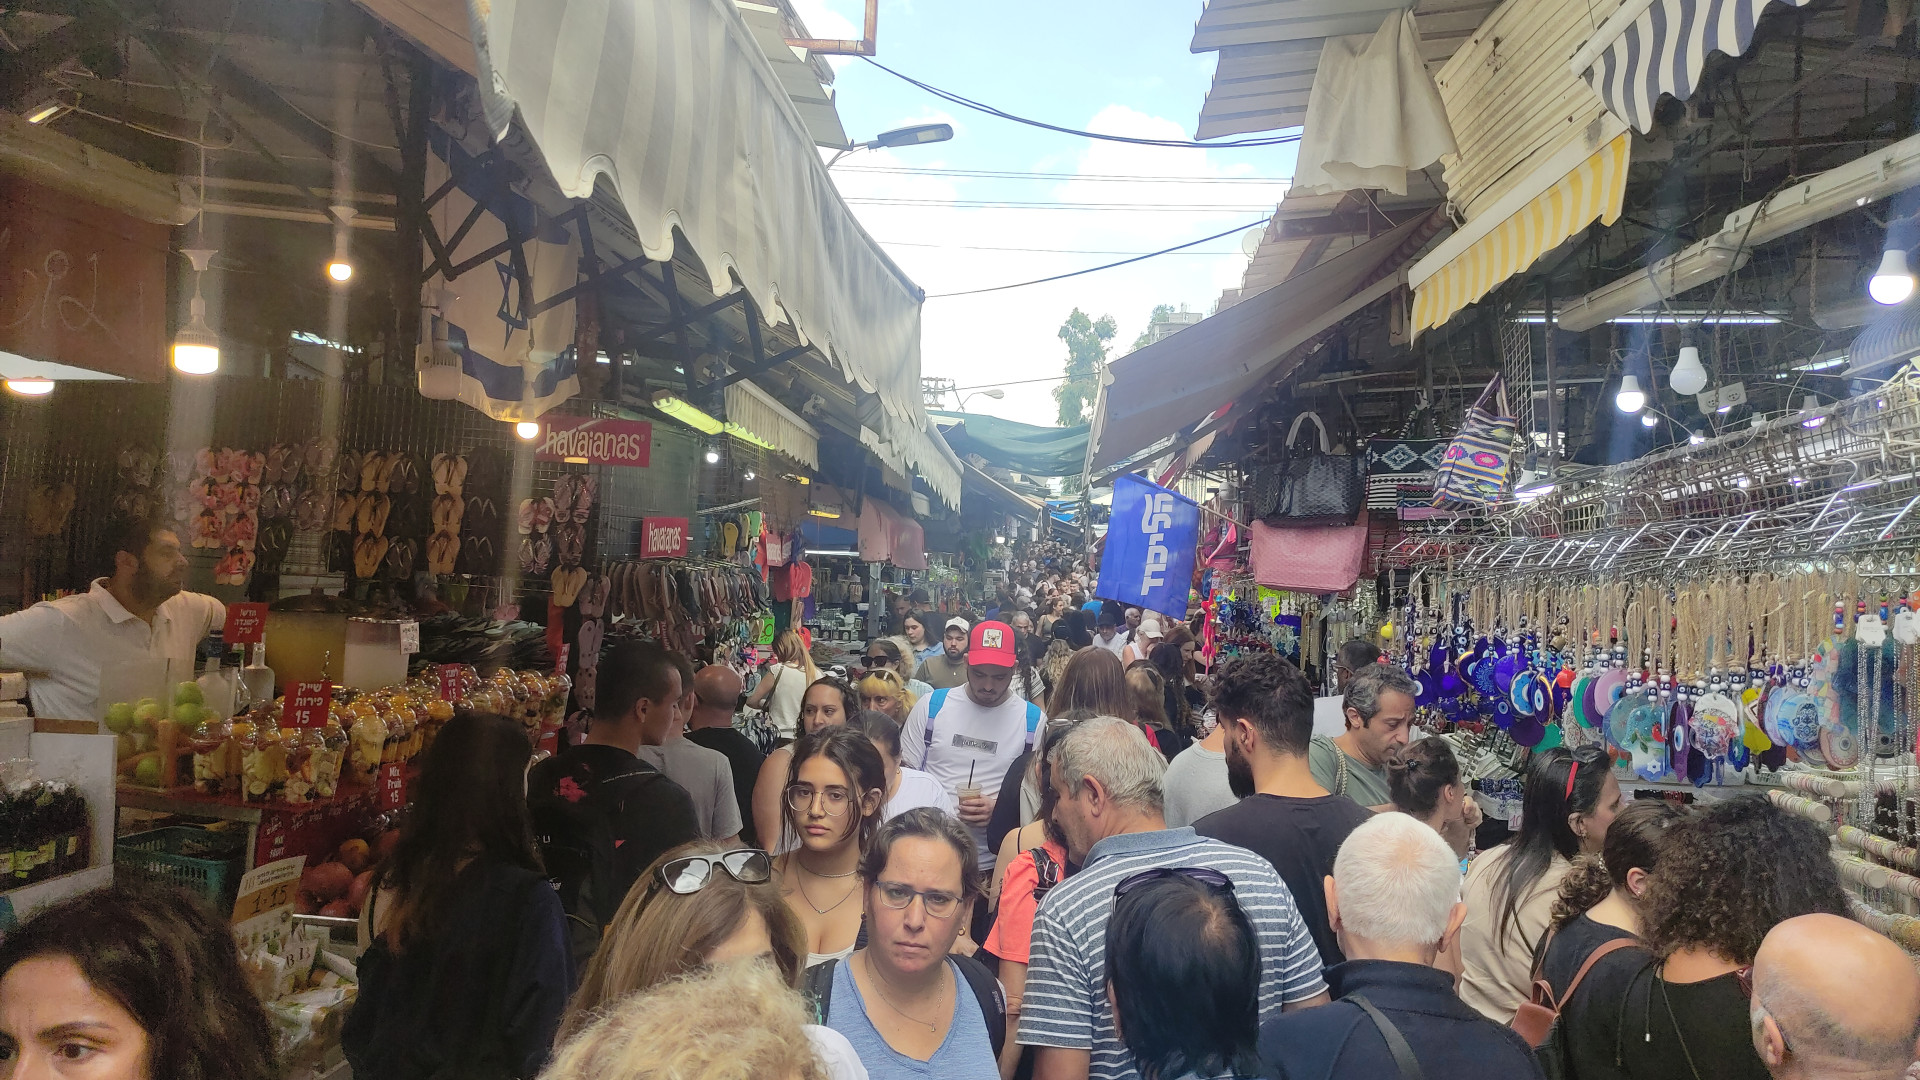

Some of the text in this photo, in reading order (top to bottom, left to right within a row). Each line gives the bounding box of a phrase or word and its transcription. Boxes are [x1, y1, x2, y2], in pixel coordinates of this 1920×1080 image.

[545, 423, 641, 461] havaianas
[647, 522, 681, 554] havaianas
[1140, 492, 1174, 596] הליכוד
[297, 682, 322, 697] שייק
[294, 696, 324, 707] פירות
[295, 709, 311, 724] 15
[389, 766, 400, 777] Mix
[387, 777, 402, 790] Fruit
[390, 789, 399, 803] 15
